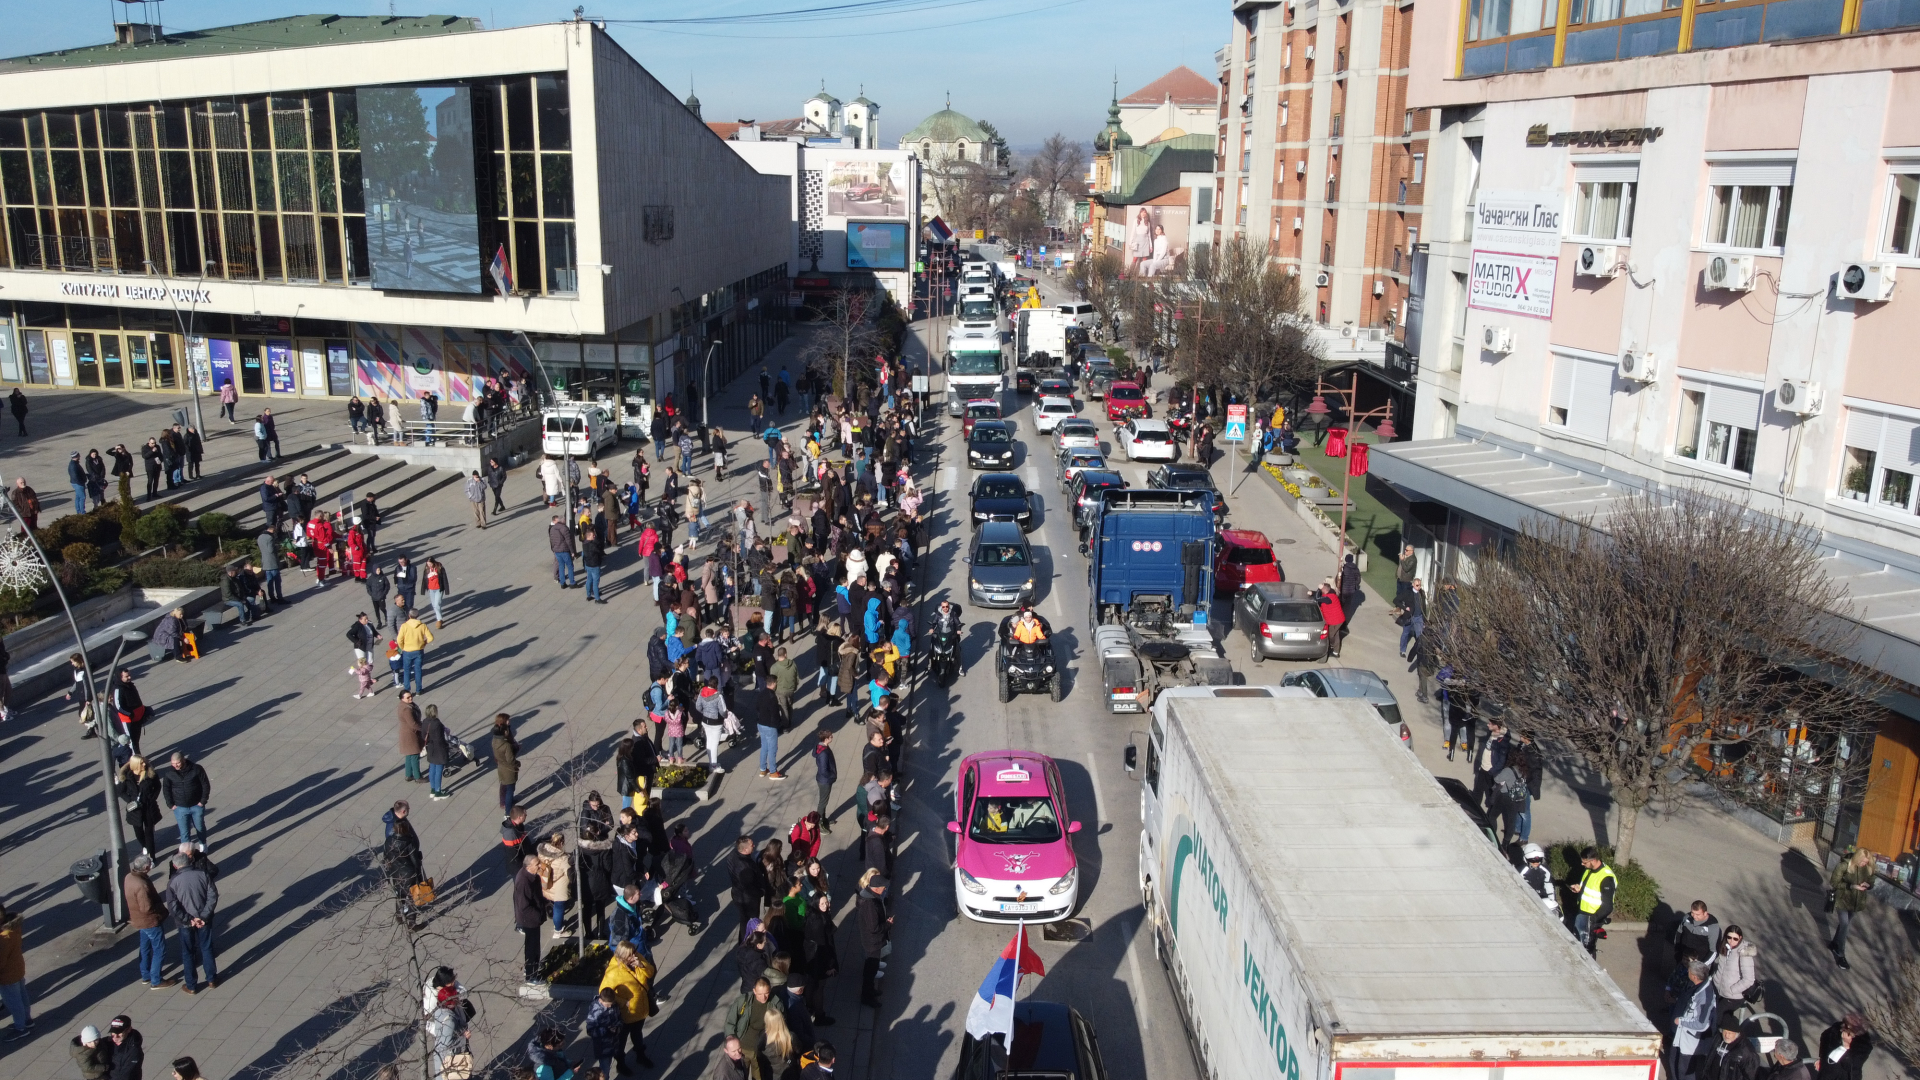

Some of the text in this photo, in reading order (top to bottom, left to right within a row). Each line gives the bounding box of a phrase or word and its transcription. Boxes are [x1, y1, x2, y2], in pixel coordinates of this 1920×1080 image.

[1553, 126, 1663, 147] EPOKSAN
[1533, 204, 1559, 228] Глас
[1476, 233, 1557, 248] www.cacanskiglas.rs
[1473, 280, 1513, 298] STUDIO
[1474, 262, 1532, 300] MATRIX
[60, 282, 212, 303] КУЛТУРНИ ЦЕНТАР ЧАЧАК
[1193, 822, 1228, 934] VIATOR
[1243, 940, 1300, 1080] VEKTOR
